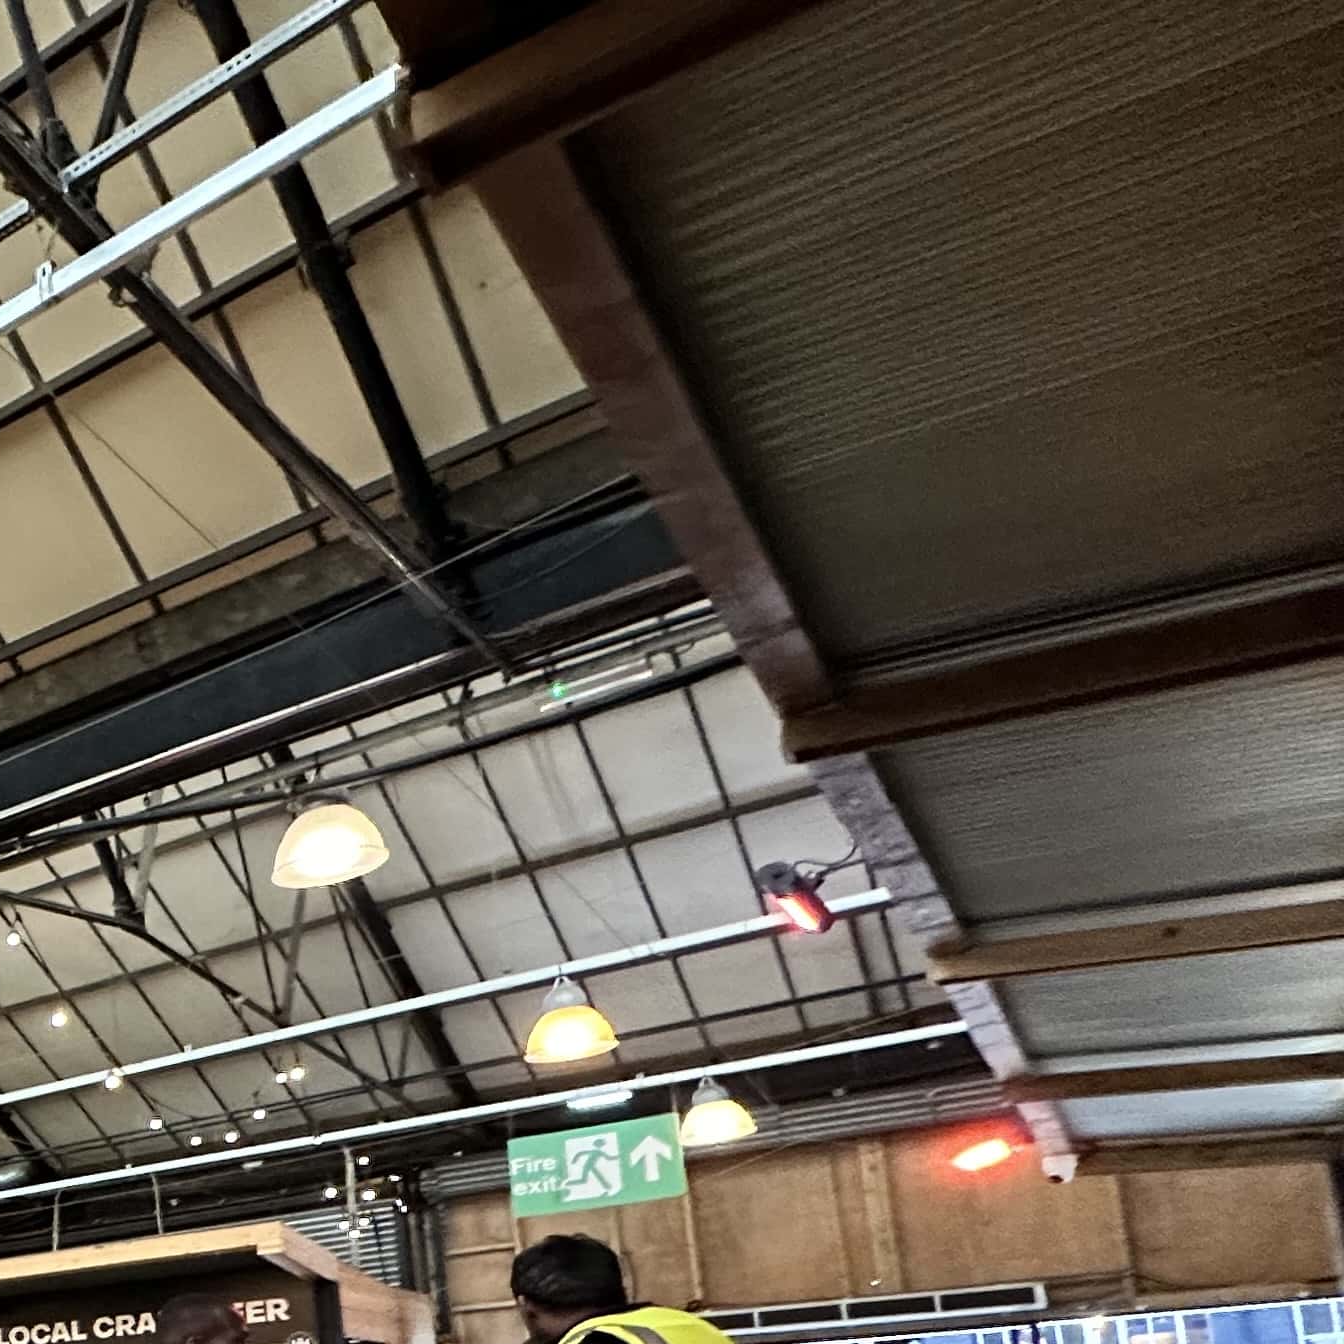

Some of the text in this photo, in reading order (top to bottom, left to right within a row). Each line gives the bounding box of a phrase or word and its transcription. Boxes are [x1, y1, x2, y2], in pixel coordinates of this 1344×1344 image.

[510, 1156, 558, 1175] Fire
[513, 1176, 559, 1196] exit
[93, 1312, 158, 1338] CRA
